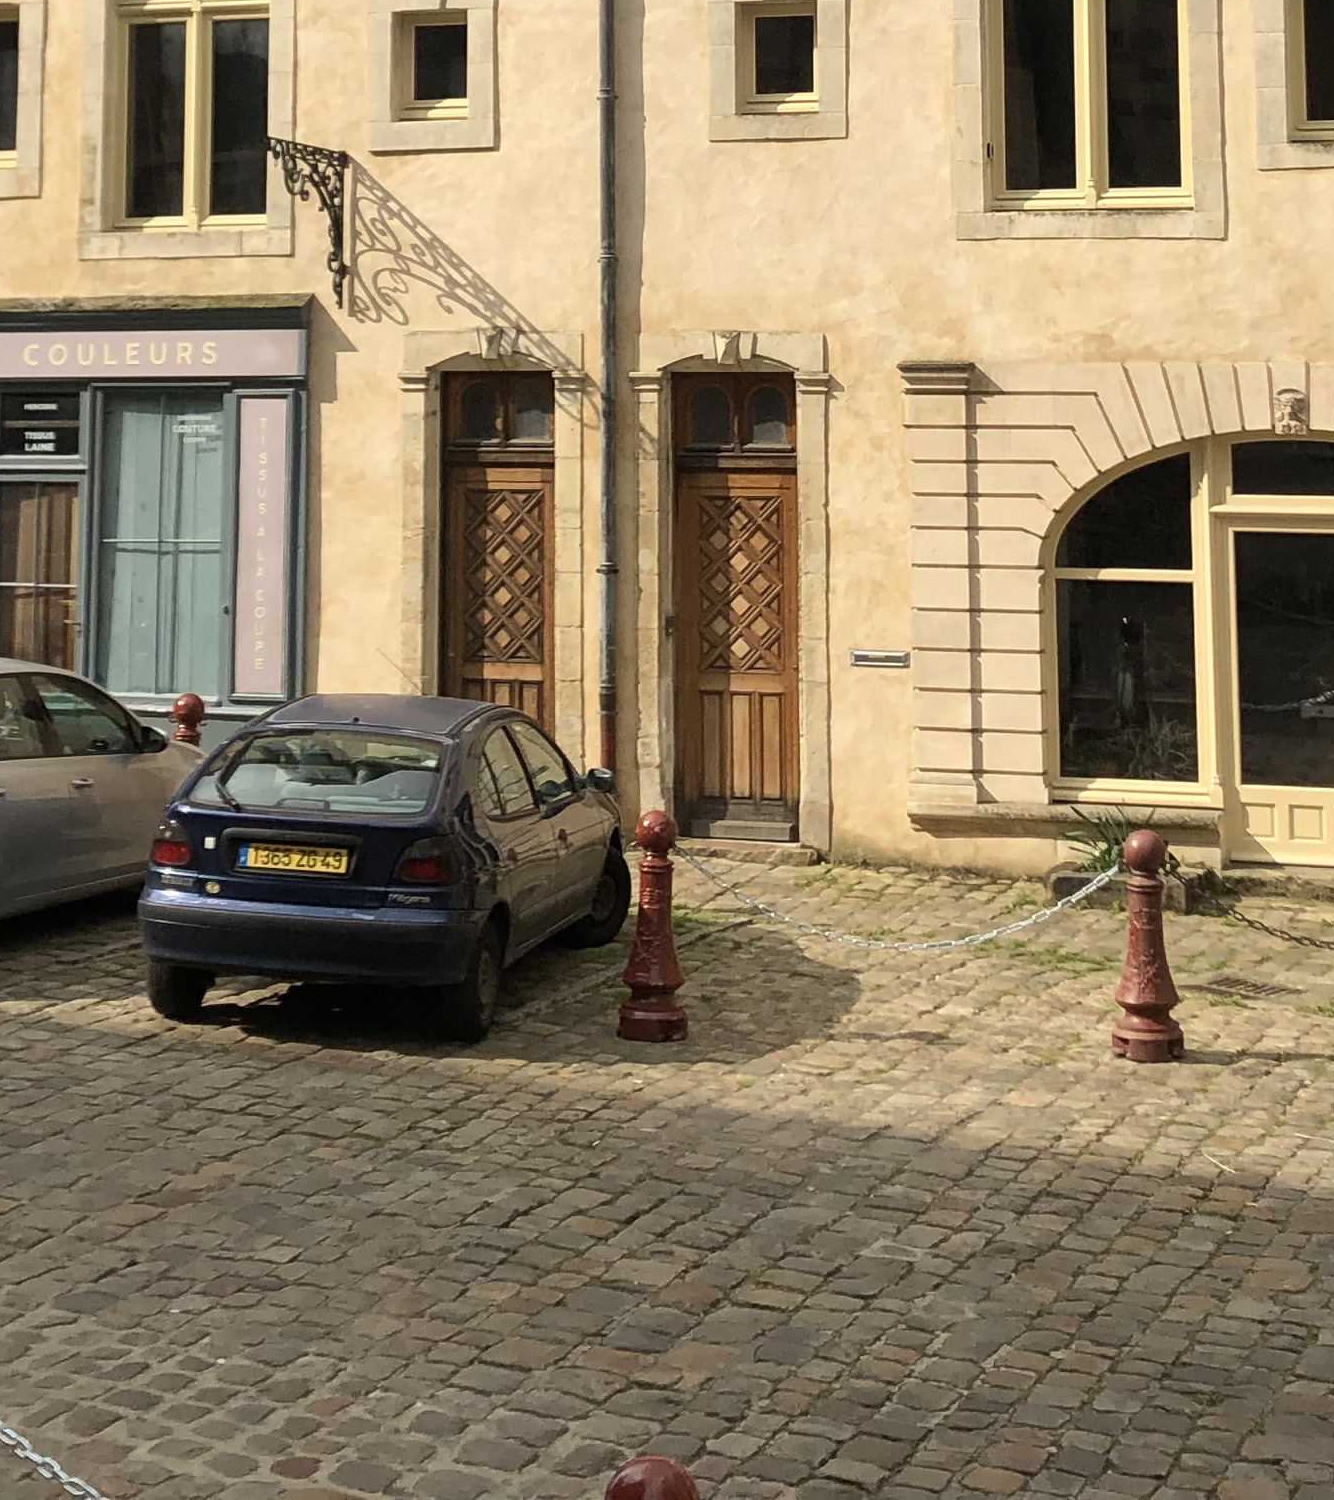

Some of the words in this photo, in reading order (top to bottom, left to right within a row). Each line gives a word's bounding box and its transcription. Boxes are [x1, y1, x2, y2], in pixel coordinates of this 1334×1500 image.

[22, 341, 218, 367] COULEURS
[24, 431, 56, 440] TISSUS
[24, 443, 56, 452] LAINE
[257, 418, 267, 515] TISSUS
[255, 549, 265, 578] LA
[254, 590, 265, 670] COUPE
[320, 850, 343, 870] 49
